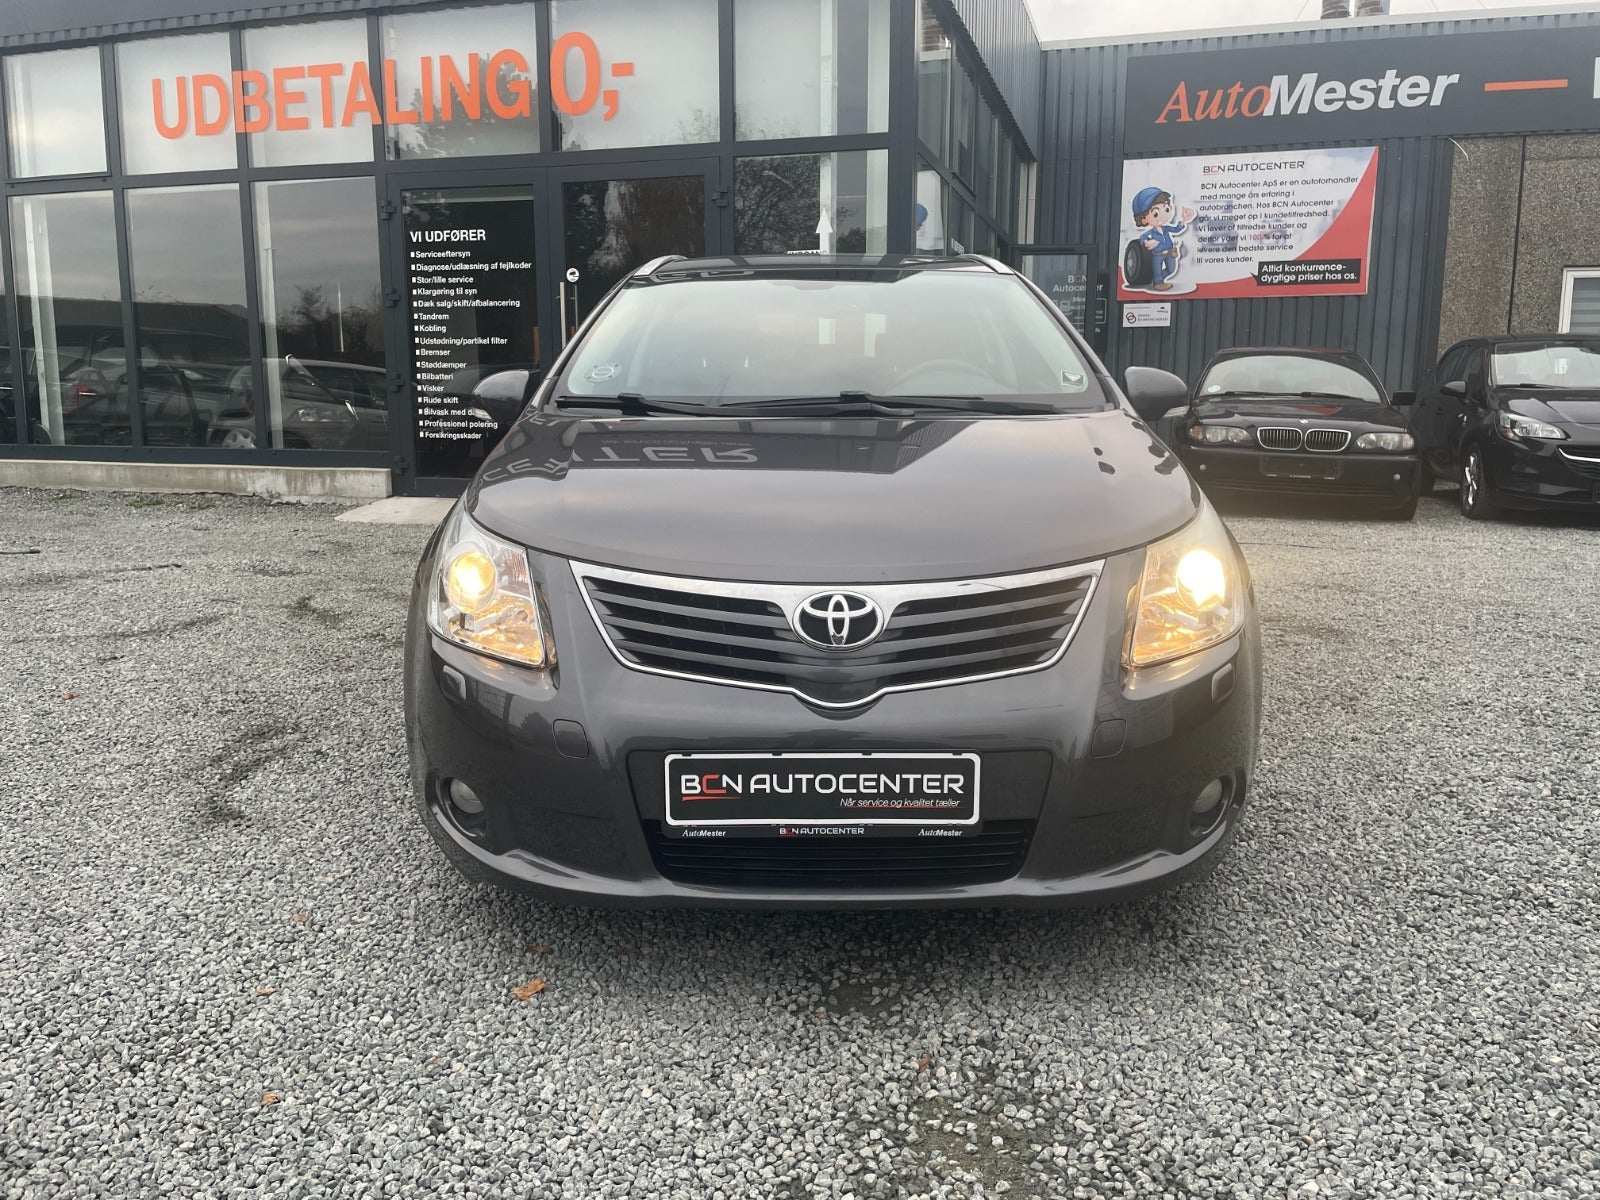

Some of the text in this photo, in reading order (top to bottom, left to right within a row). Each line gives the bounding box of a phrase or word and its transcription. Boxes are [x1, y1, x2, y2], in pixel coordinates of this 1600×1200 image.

[151, 48, 531, 140] UDBETALING
[1154, 69, 1459, 124] AutoMester
[1203, 160, 1304, 174] BCN AUTOCENTER
[1218, 181, 1260, 189] Autocenter
[1262, 180, 1278, 188] ApS
[1300, 176, 1358, 185] autoforhandler
[1261, 190, 1290, 198] erfaring
[1200, 203, 1254, 211] autobranchen.
[1290, 199, 1334, 208] Autocenter
[1222, 214, 1246, 222] meget
[1264, 210, 1330, 219] kundetilfredshed.
[410, 229, 486, 242] VI UDFØRER
[416, 250, 470, 258] Serviceeftersyn
[416, 261, 532, 272] Diagnose/udlæsning af fejlkoder
[1262, 264, 1346, 272] Altid konkurrence-
[416, 276, 446, 284] Stor/lille
[1261, 274, 1296, 283] dygtige
[1298, 272, 1324, 282] priser
[1325, 272, 1342, 280] hos
[418, 288, 454, 296] Klargøring
[436, 300, 520, 308] salg/skift/afbalancering
[420, 324, 446, 333] Kobling
[420, 336, 508, 346] Udstødning/partikel filter
[420, 361, 466, 370] Støddæmper
[469, 420, 498, 430] polering
[424, 432, 482, 440] Forsikringsskader
[680, 774, 964, 794] BCN AUTOCENTER
[840, 798, 960, 808] Når service og kvalitet tæller
[682, 829, 726, 838] AutoMester
[780, 827, 864, 836] BCN AUTOCENTER
[918, 828, 963, 838] AutoMester
